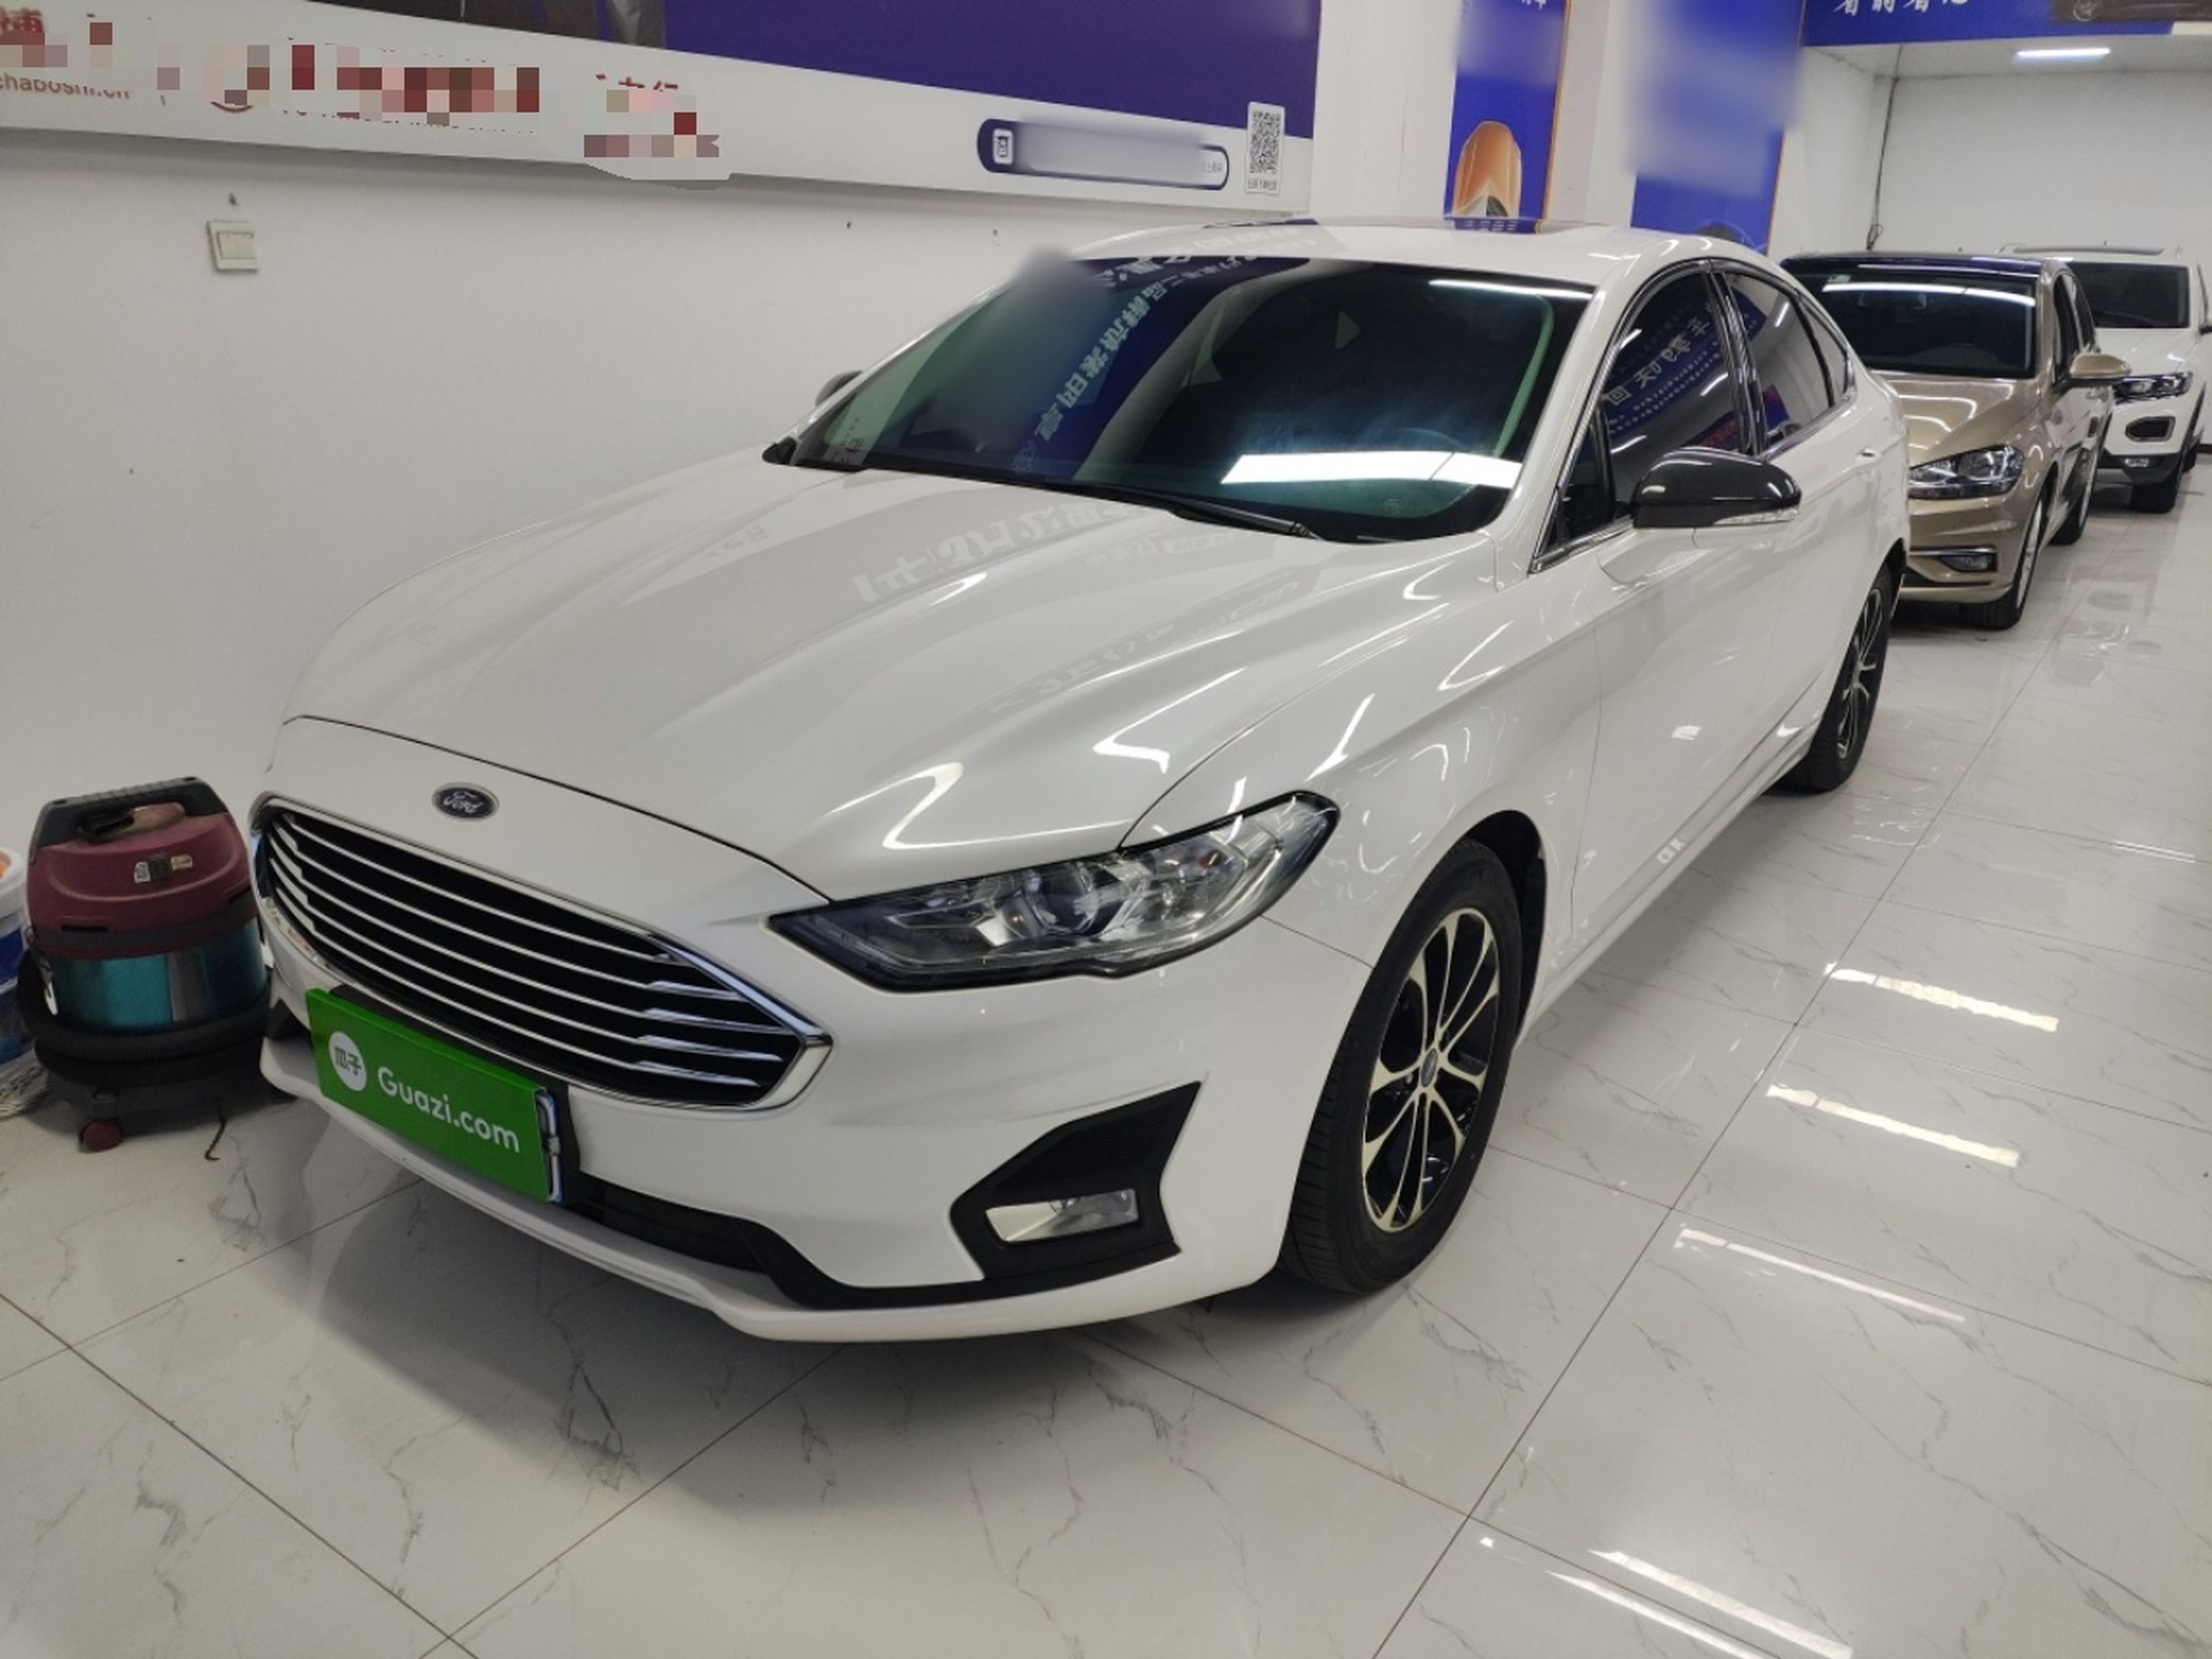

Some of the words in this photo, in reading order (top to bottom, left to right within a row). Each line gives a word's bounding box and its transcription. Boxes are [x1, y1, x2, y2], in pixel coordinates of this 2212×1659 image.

[443, 790, 484, 813] Ford
[334, 1046, 363, 1076] 瓜子
[377, 1066, 520, 1153] Guazi.com
